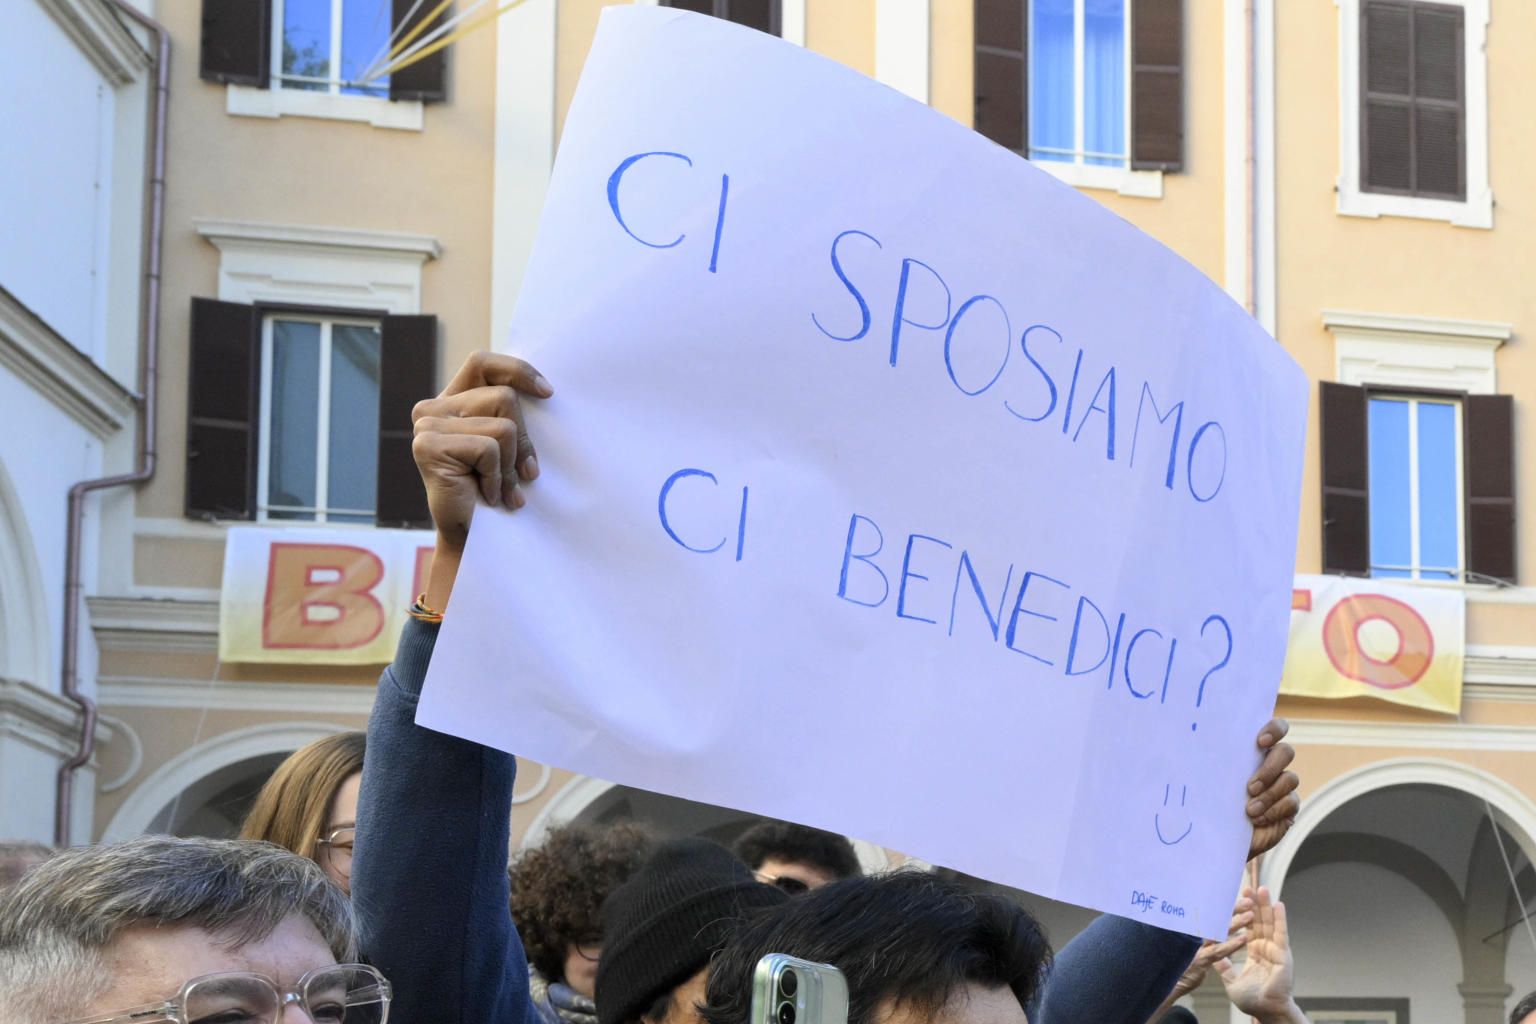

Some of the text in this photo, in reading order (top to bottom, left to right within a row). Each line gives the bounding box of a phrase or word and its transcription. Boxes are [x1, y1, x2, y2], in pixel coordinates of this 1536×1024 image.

[607, 152, 1228, 503] CI SPOSIAMO
[658, 468, 748, 562] CI
[836, 513, 1233, 731] BENEDICI?
